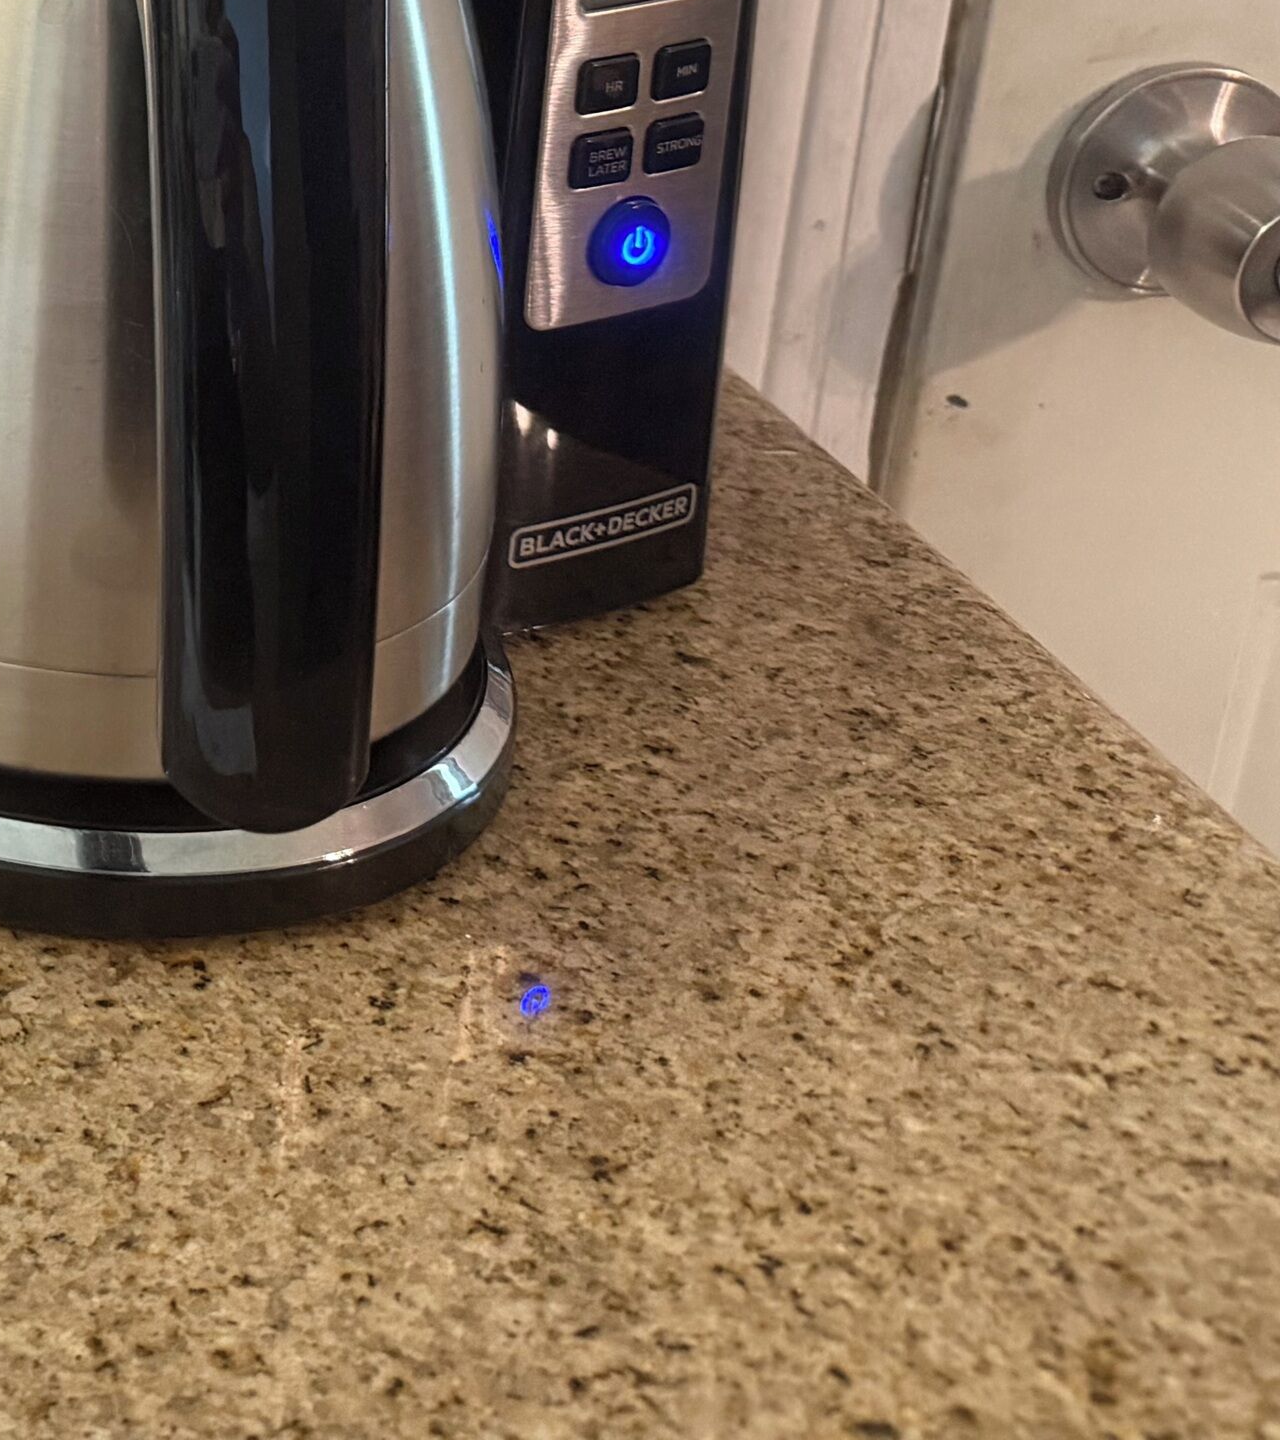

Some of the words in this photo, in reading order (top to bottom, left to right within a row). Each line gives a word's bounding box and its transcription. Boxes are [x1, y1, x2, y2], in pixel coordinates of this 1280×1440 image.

[676, 63, 697, 78] MIN
[605, 80, 623, 94] HR
[656, 135, 703, 155] STRONG
[589, 146, 627, 163] BREW
[588, 161, 626, 178] LATER
[519, 496, 688, 556] BLACK+DECKER
